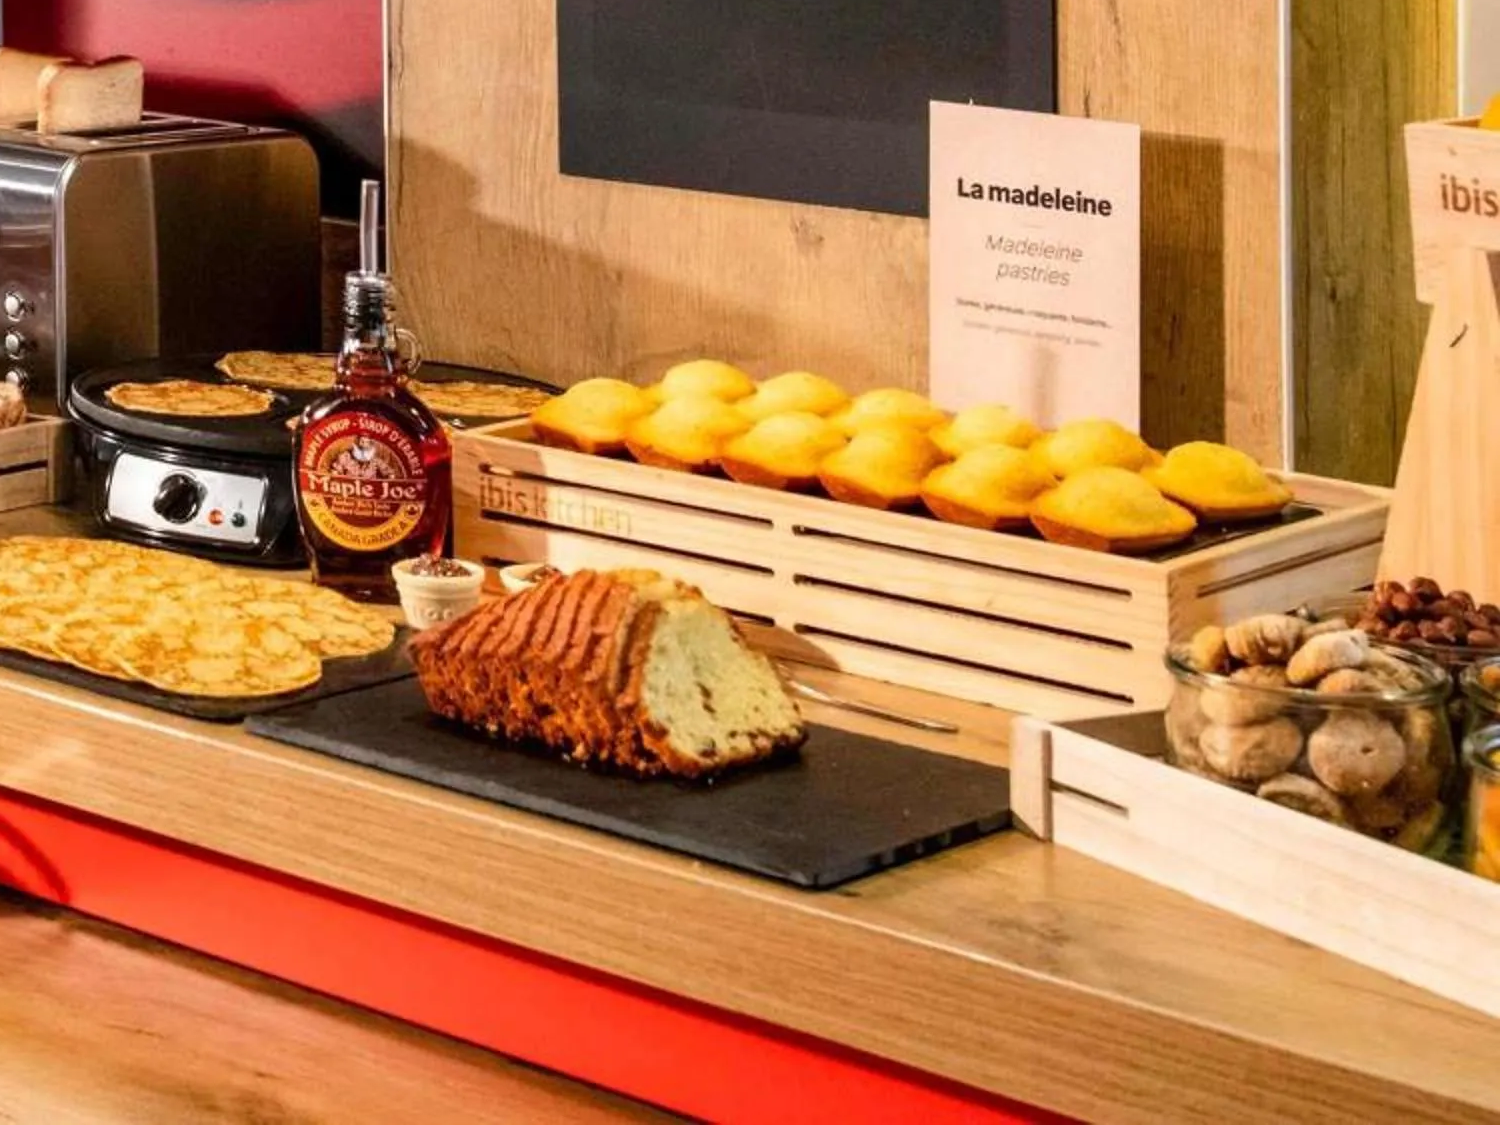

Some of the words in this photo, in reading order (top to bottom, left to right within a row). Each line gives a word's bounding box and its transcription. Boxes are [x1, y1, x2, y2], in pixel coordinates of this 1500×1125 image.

[957, 177, 984, 200] La
[989, 186, 1113, 217] madeleine
[1441, 173, 1499, 218] ibis
[985, 234, 1083, 264] Madeleine
[995, 261, 1071, 287] pastries
[308, 472, 375, 498] Maple
[479, 476, 529, 515] ibis
